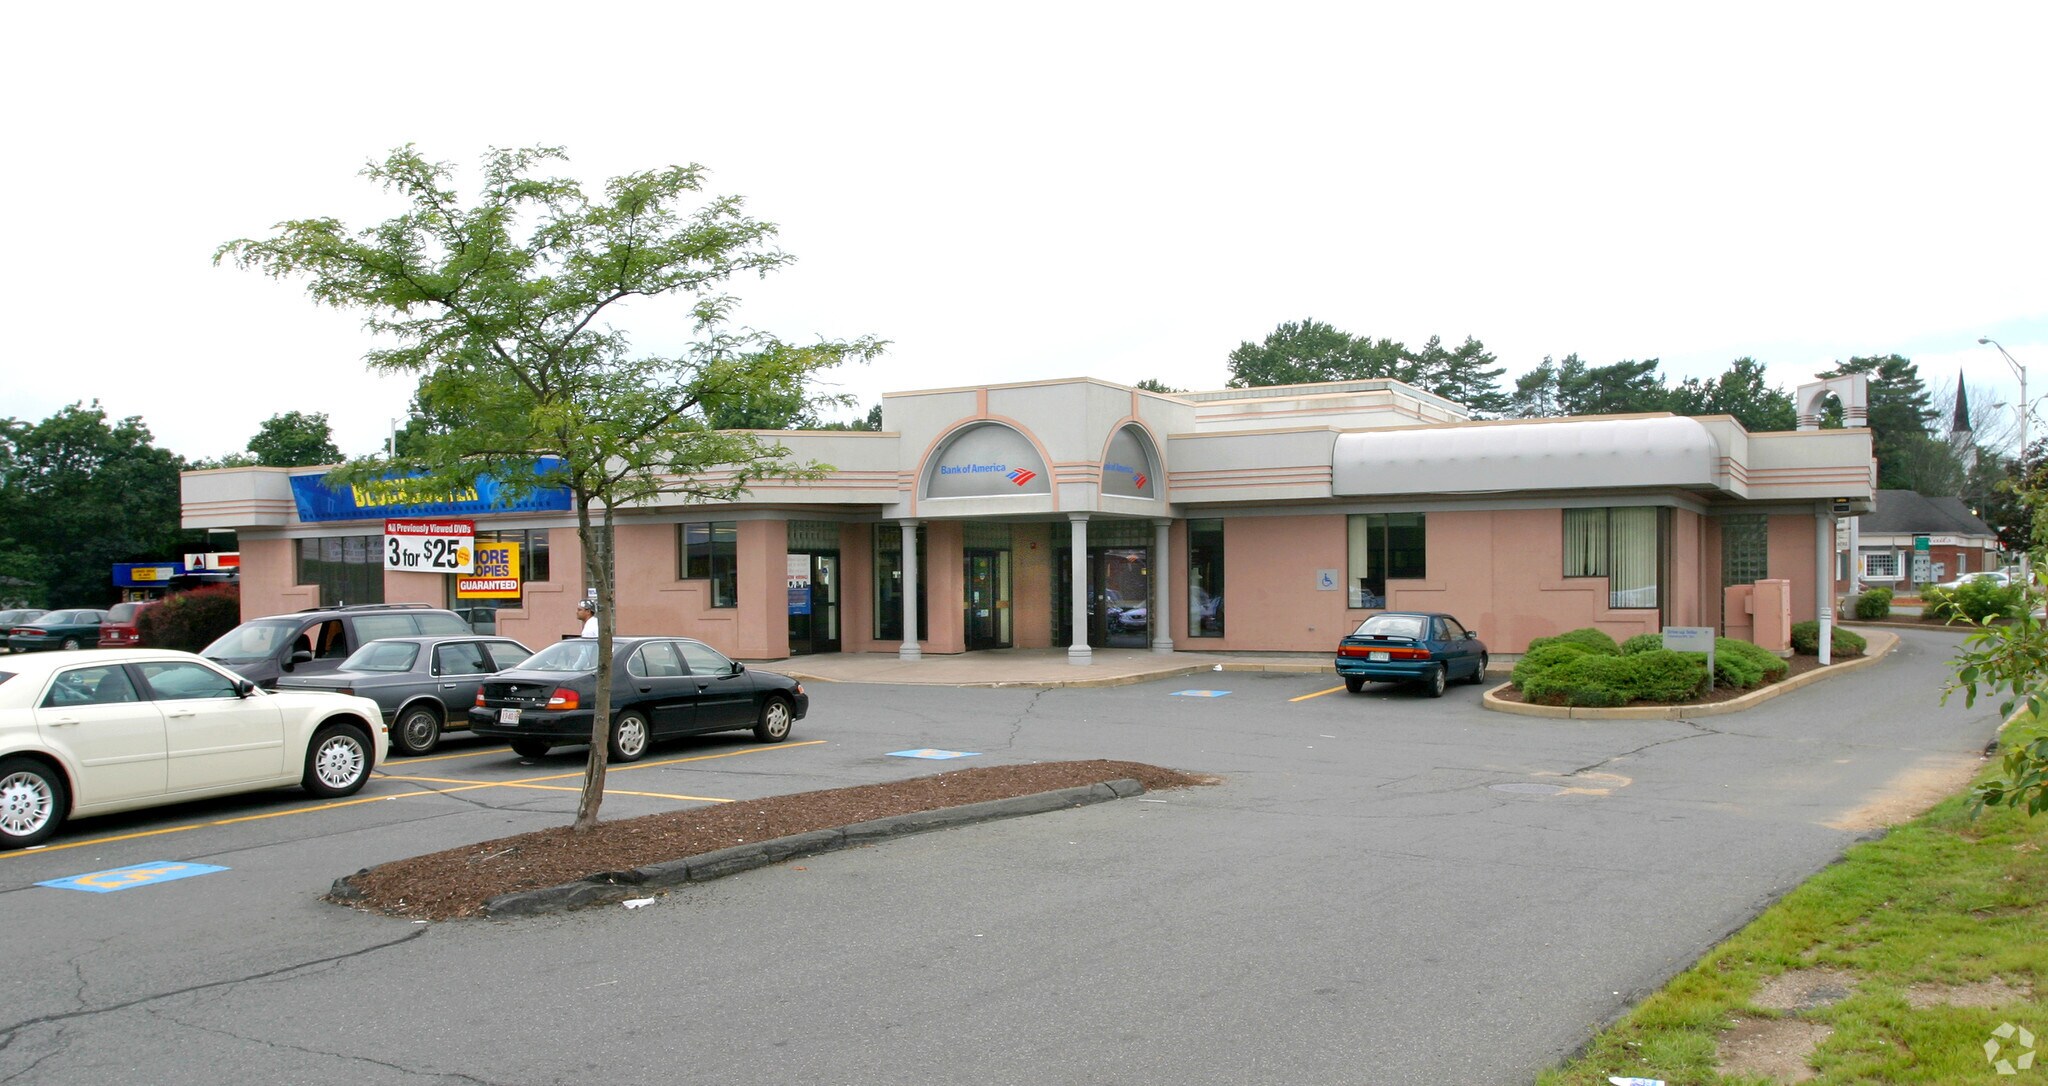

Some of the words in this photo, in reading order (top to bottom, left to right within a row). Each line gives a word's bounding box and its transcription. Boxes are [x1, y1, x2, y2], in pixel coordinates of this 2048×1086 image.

[941, 465, 961, 475] Bank
[962, 464, 970, 473] of
[971, 463, 1006, 473] America
[397, 523, 428, 535] Previously
[430, 524, 453, 534] Viewed
[388, 537, 400, 566] 3
[403, 548, 420, 567] for
[423, 538, 460, 568] $25
[460, 580, 517, 590] GUARANTEED
